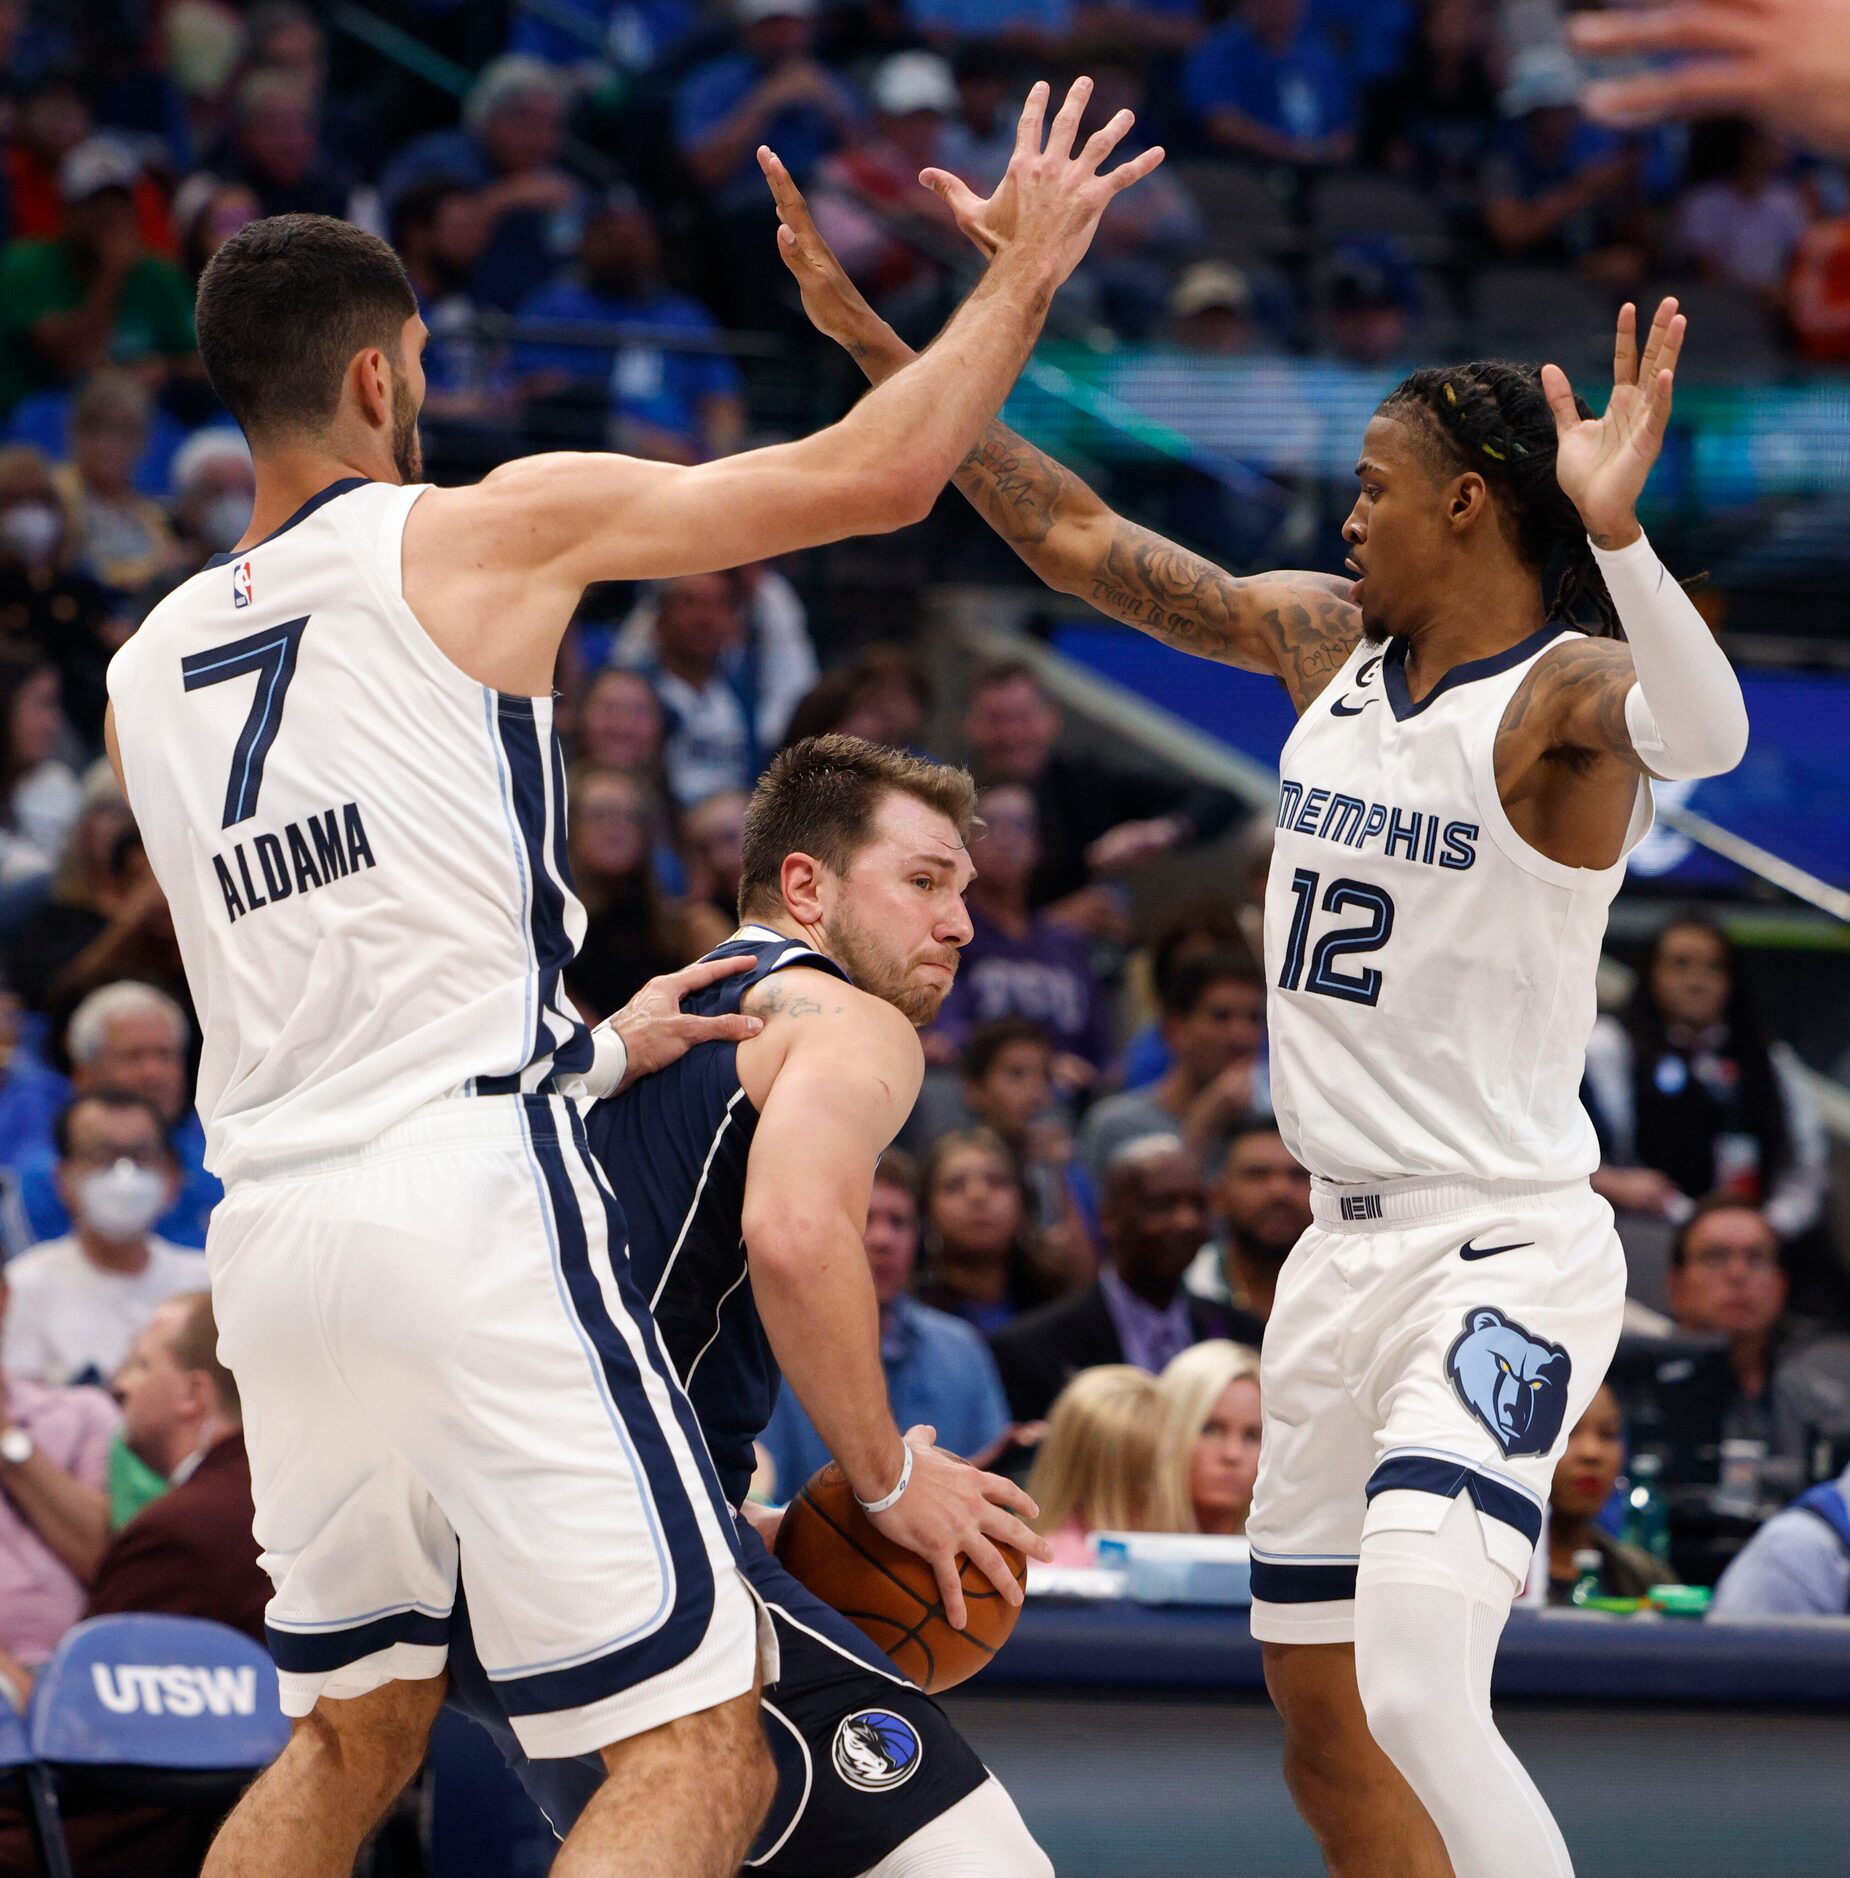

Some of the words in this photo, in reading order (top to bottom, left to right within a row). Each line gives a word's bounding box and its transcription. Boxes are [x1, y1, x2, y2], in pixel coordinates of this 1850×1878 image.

[181, 614, 311, 830] 7
[212, 802, 376, 924] ALDAMA
[1277, 780, 1480, 871] MEMPHIS
[1278, 867, 1395, 1007] 12
[91, 1662, 257, 1717] UTSW
